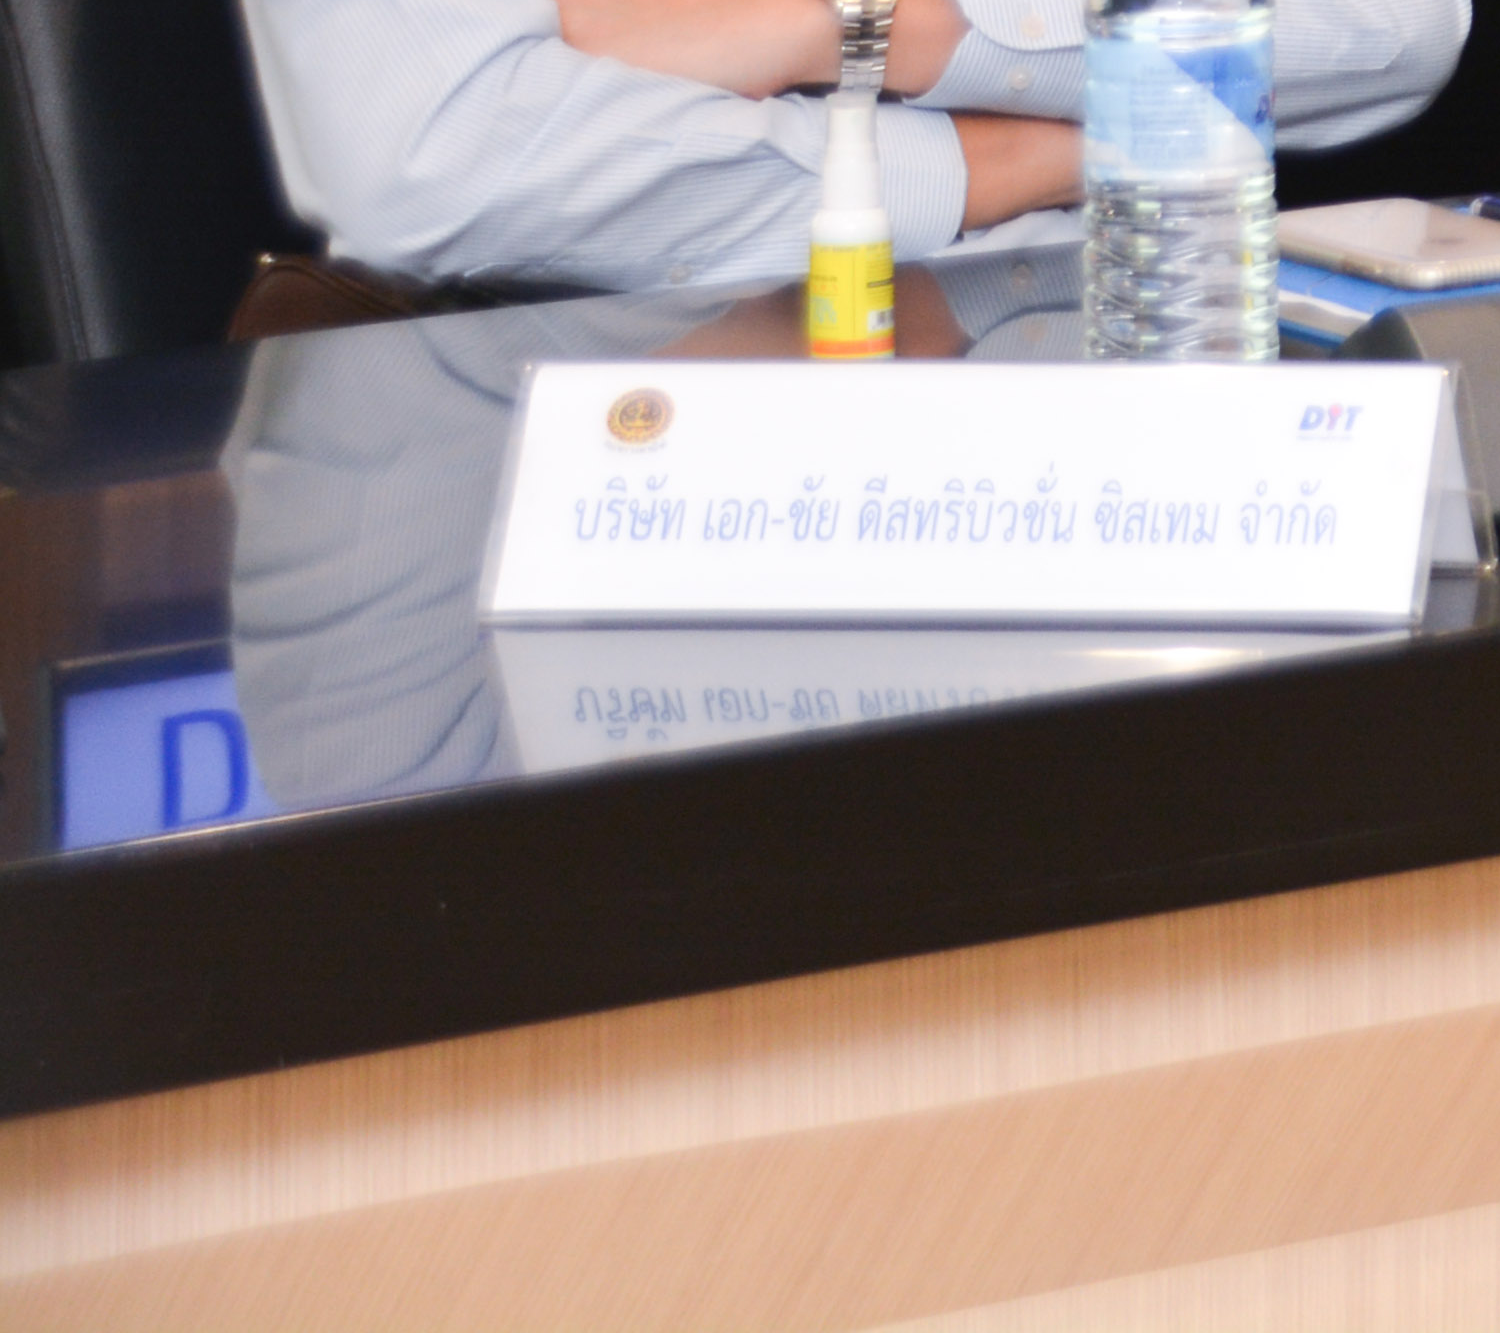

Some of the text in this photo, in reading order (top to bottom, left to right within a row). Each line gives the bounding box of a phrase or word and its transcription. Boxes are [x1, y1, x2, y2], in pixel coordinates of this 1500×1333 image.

[1299, 403, 1364, 431] DIT
[575, 474, 687, 541] บริษัท
[703, 474, 841, 542] เอก-ชัย
[1095, 478, 1221, 544] ซิสเทม
[1240, 478, 1339, 545] จำกัด
